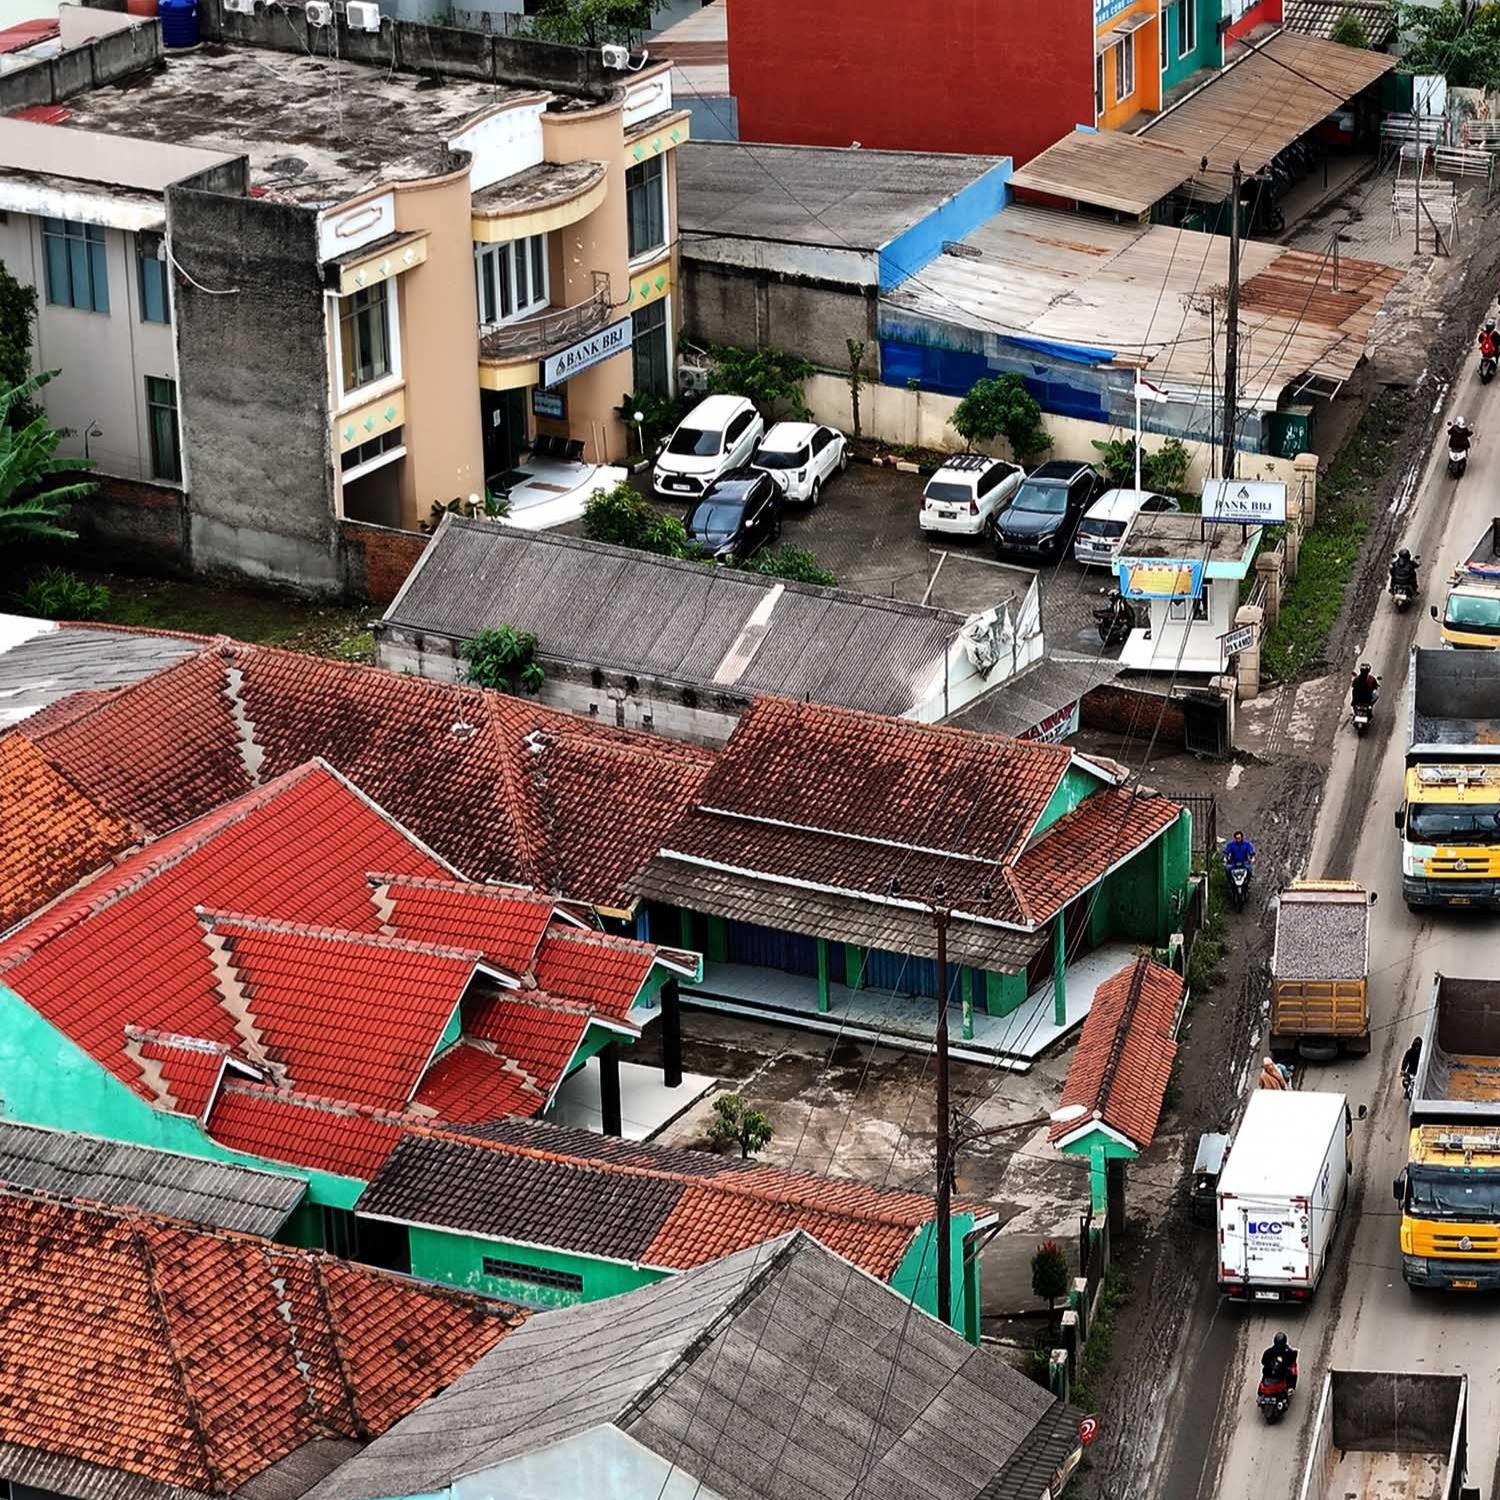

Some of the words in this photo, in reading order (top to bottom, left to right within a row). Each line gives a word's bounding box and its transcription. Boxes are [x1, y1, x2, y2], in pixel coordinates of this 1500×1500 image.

[566, 339, 600, 367] BANK
[602, 328, 624, 350] BBJ
[1216, 500, 1248, 511] BANK
